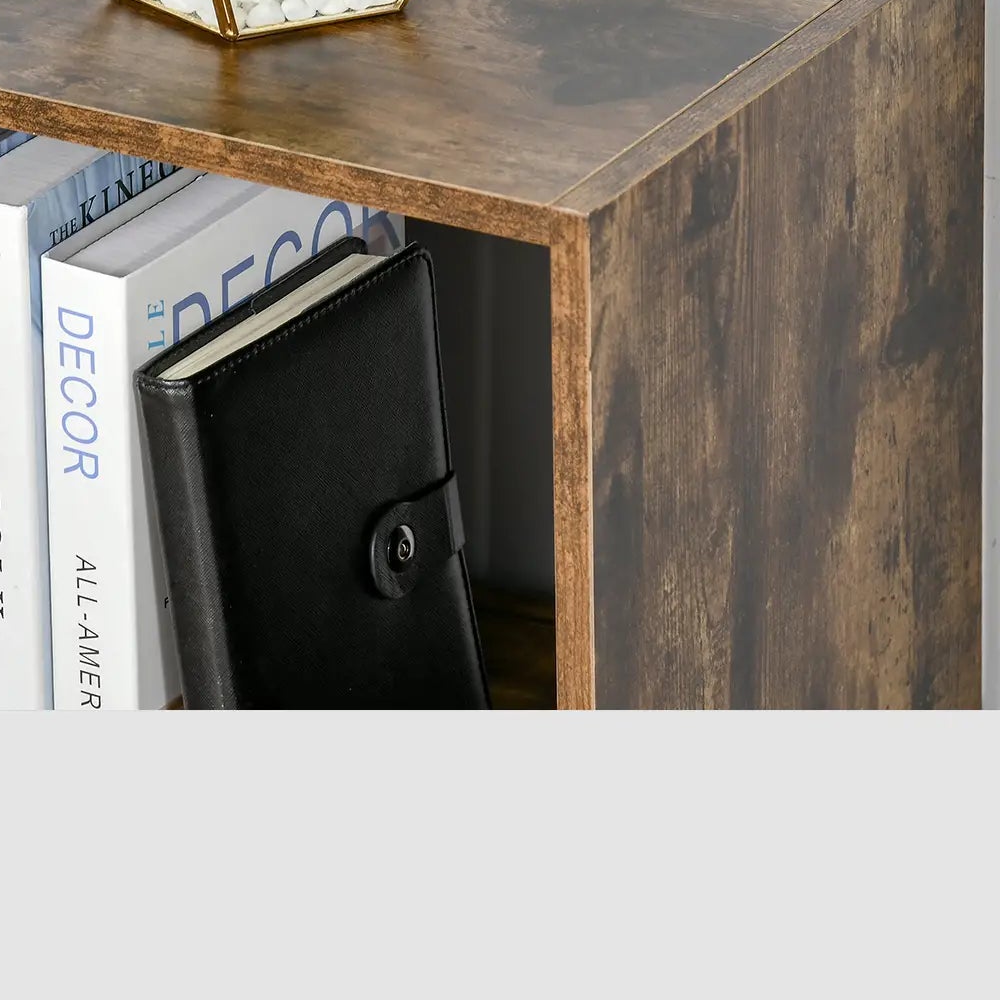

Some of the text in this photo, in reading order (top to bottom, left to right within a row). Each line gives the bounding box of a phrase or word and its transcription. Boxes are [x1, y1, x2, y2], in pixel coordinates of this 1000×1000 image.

[49, 217, 79, 247] THE
[57, 306, 99, 480] DECOR
[75, 554, 102, 710] ALL-AMER
